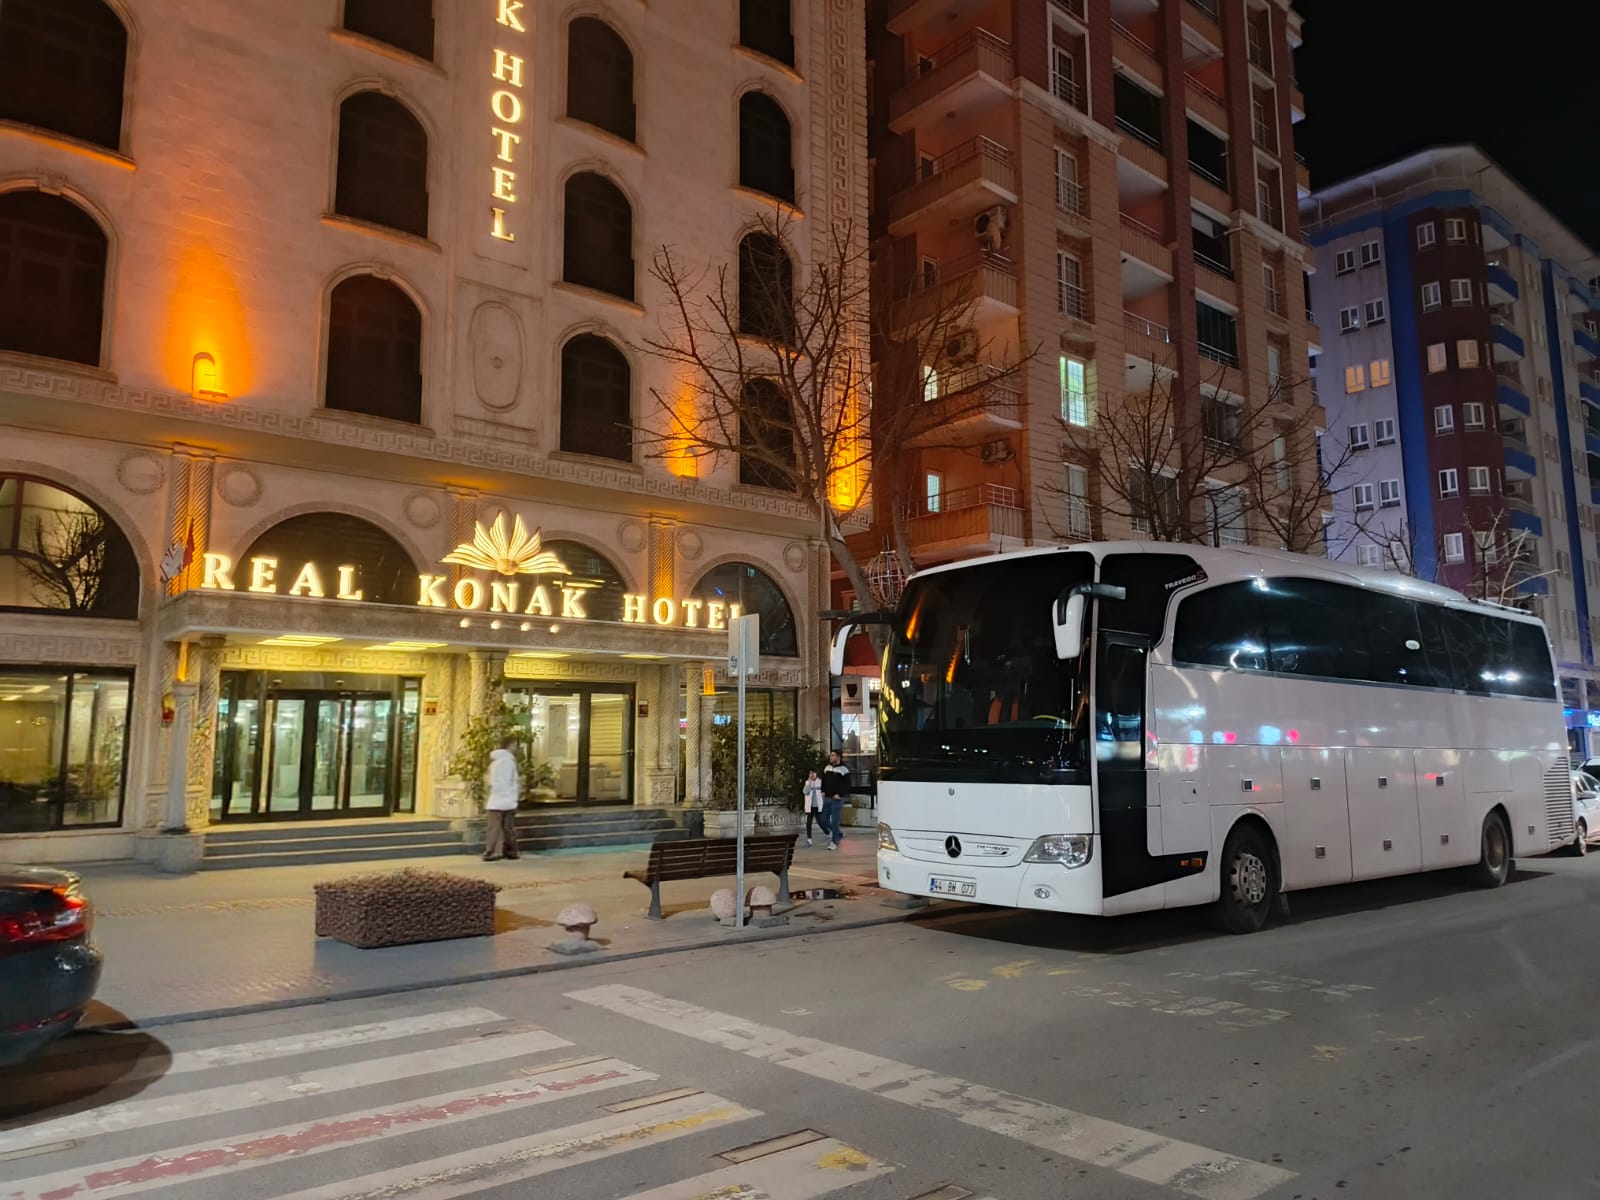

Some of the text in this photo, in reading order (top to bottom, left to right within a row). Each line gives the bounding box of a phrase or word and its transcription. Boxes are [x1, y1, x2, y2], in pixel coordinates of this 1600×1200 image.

[491, 48, 524, 243] HOTEL
[200, 552, 363, 601] REAL
[416, 574, 588, 619] KONAK
